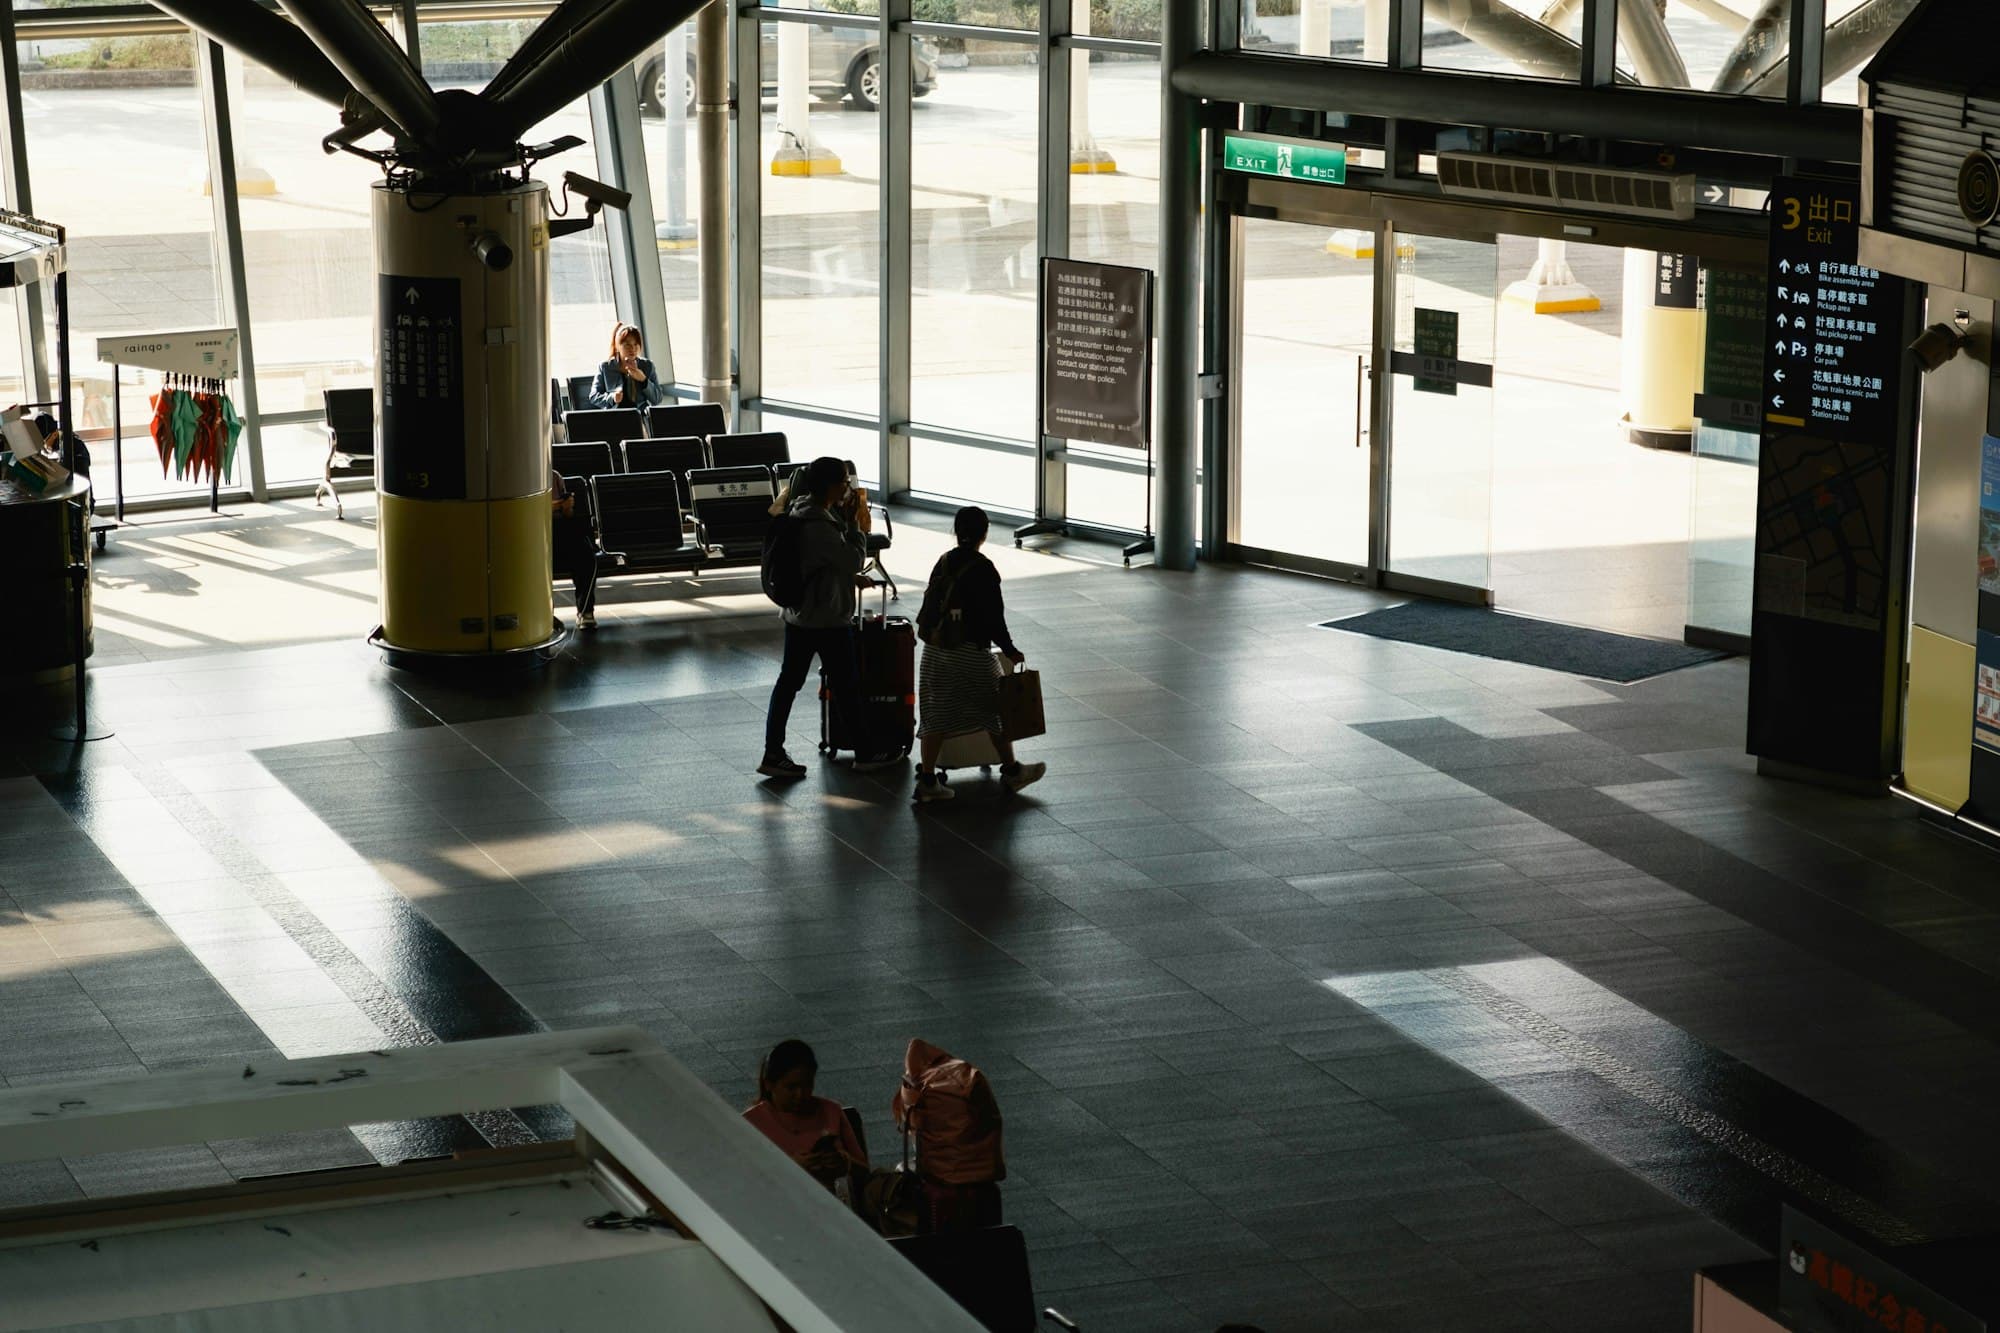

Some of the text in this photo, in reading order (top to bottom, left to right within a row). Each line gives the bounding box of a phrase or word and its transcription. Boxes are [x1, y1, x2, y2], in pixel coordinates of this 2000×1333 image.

[1236, 156, 1267, 169] EXIT
[1302, 165, 1336, 179] 緊急出口
[1781, 191, 1853, 231] 3 出口
[1807, 226, 1833, 245] Exit
[1660, 253, 1674, 296] 載客區
[1817, 301, 1837, 312] Pickup
[1815, 315, 1877, 335] 計程車乘車區
[1815, 328, 1828, 337] Taxi
[1828, 330, 1849, 340] pickup
[1056, 336, 1133, 354] If you encounter taxi driver
[1790, 340, 1845, 358] P3 停車場
[1056, 347, 1125, 364] illegal solicitation, please
[1814, 355, 1825, 364] Car
[1057, 359, 1078, 368] contact
[1089, 364, 1108, 372] station
[1110, 366, 1127, 376] staffs,
[1056, 370, 1078, 380] security
[1087, 373, 1096, 381] the
[1097, 375, 1116, 384] police.
[1830, 386, 1845, 395] train
[1865, 391, 1880, 400] park
[1811, 396, 1852, 414] 車站廣場
[1811, 409, 1850, 422] Station plaza
[418, 472, 431, 488] 3
